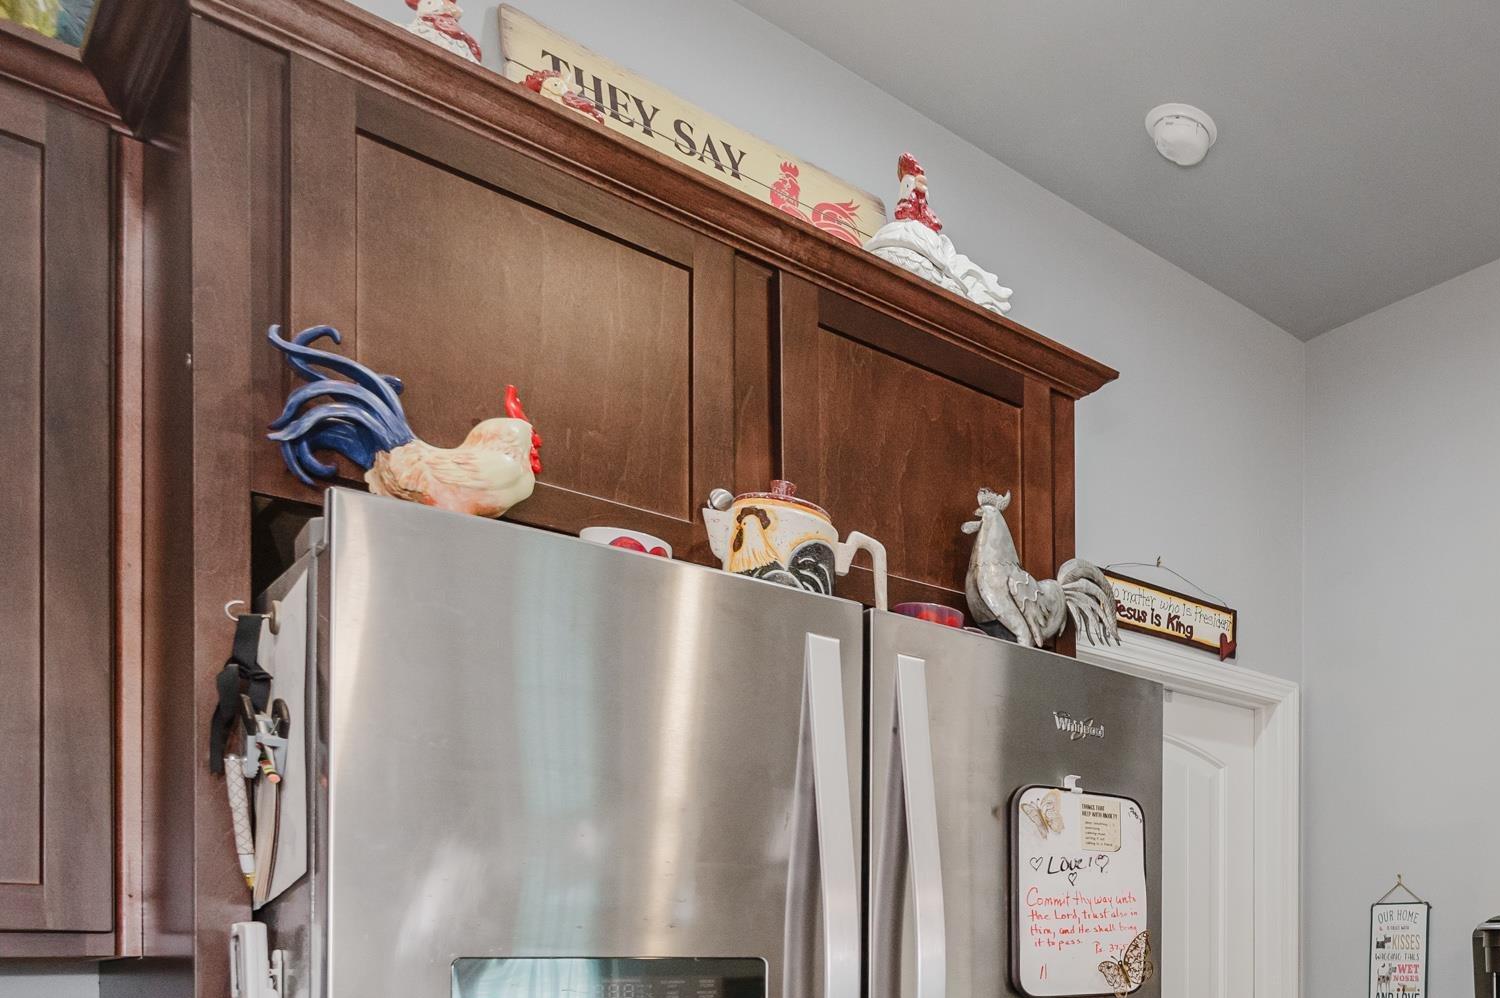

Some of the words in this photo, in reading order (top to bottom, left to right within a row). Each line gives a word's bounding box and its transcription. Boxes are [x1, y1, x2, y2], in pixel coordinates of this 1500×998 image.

[541, 49, 660, 138] THEY
[673, 119, 748, 181] SAY
[1122, 588, 1157, 608] matter
[1160, 597, 1180, 613] who
[1194, 606, 1232, 632] President
[1166, 613, 1194, 640] King
[1053, 711, 1105, 741] Whirlpool
[1027, 887, 1070, 907] Commit
[1082, 907, 1108, 919] trust
[1378, 910, 1394, 924] OUR
[1397, 909, 1420, 924] HOME
[1093, 923, 1116, 933] shall
[1392, 934, 1420, 950] KISSES
[1397, 963, 1420, 974] WET
